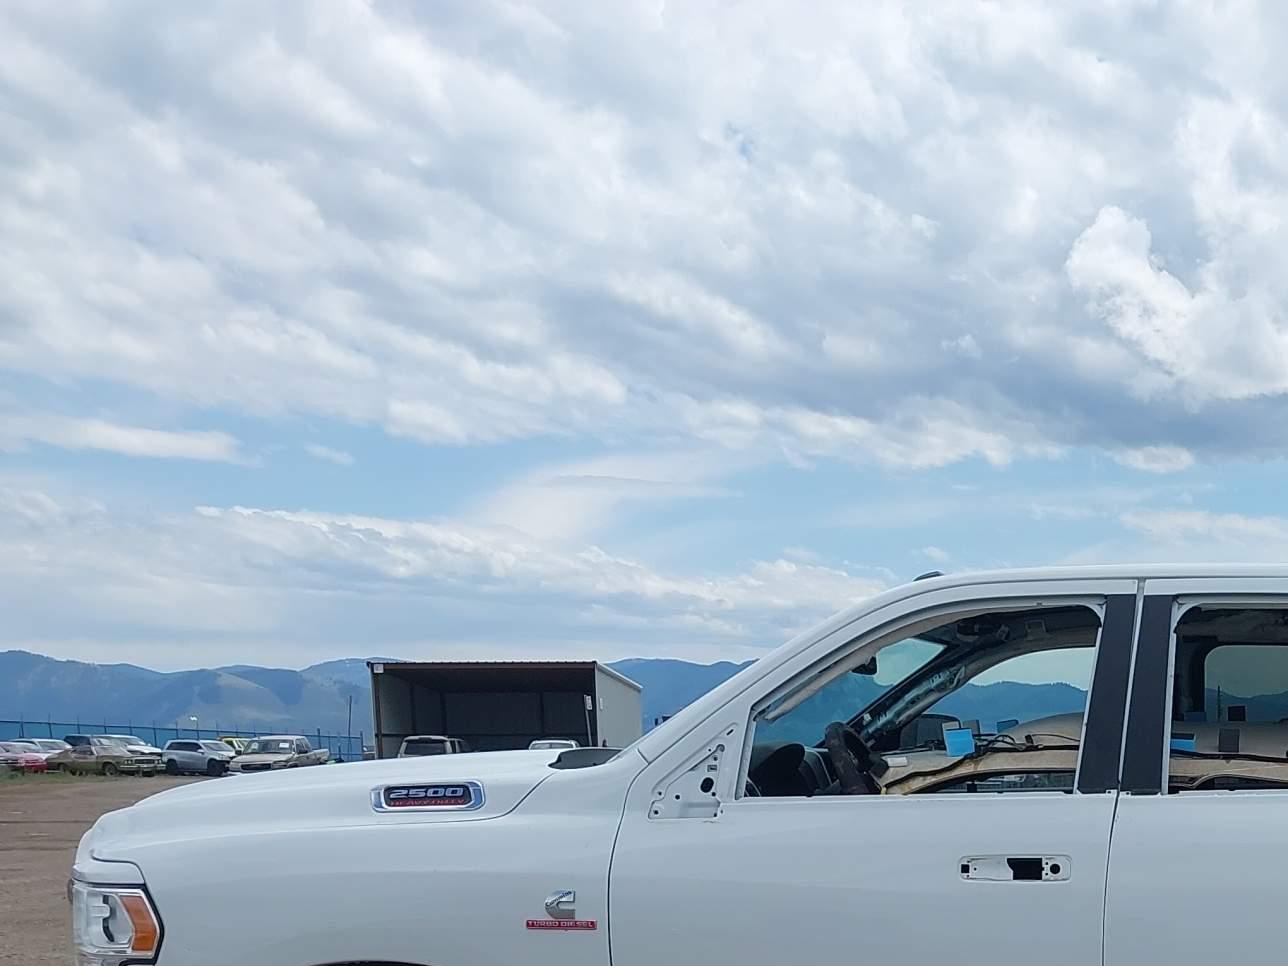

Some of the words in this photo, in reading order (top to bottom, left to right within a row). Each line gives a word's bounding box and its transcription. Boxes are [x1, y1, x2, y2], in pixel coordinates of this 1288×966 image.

[389, 787, 464, 799] 2500
[527, 920, 559, 928] TURBO
[560, 920, 593, 928] DIESEL
